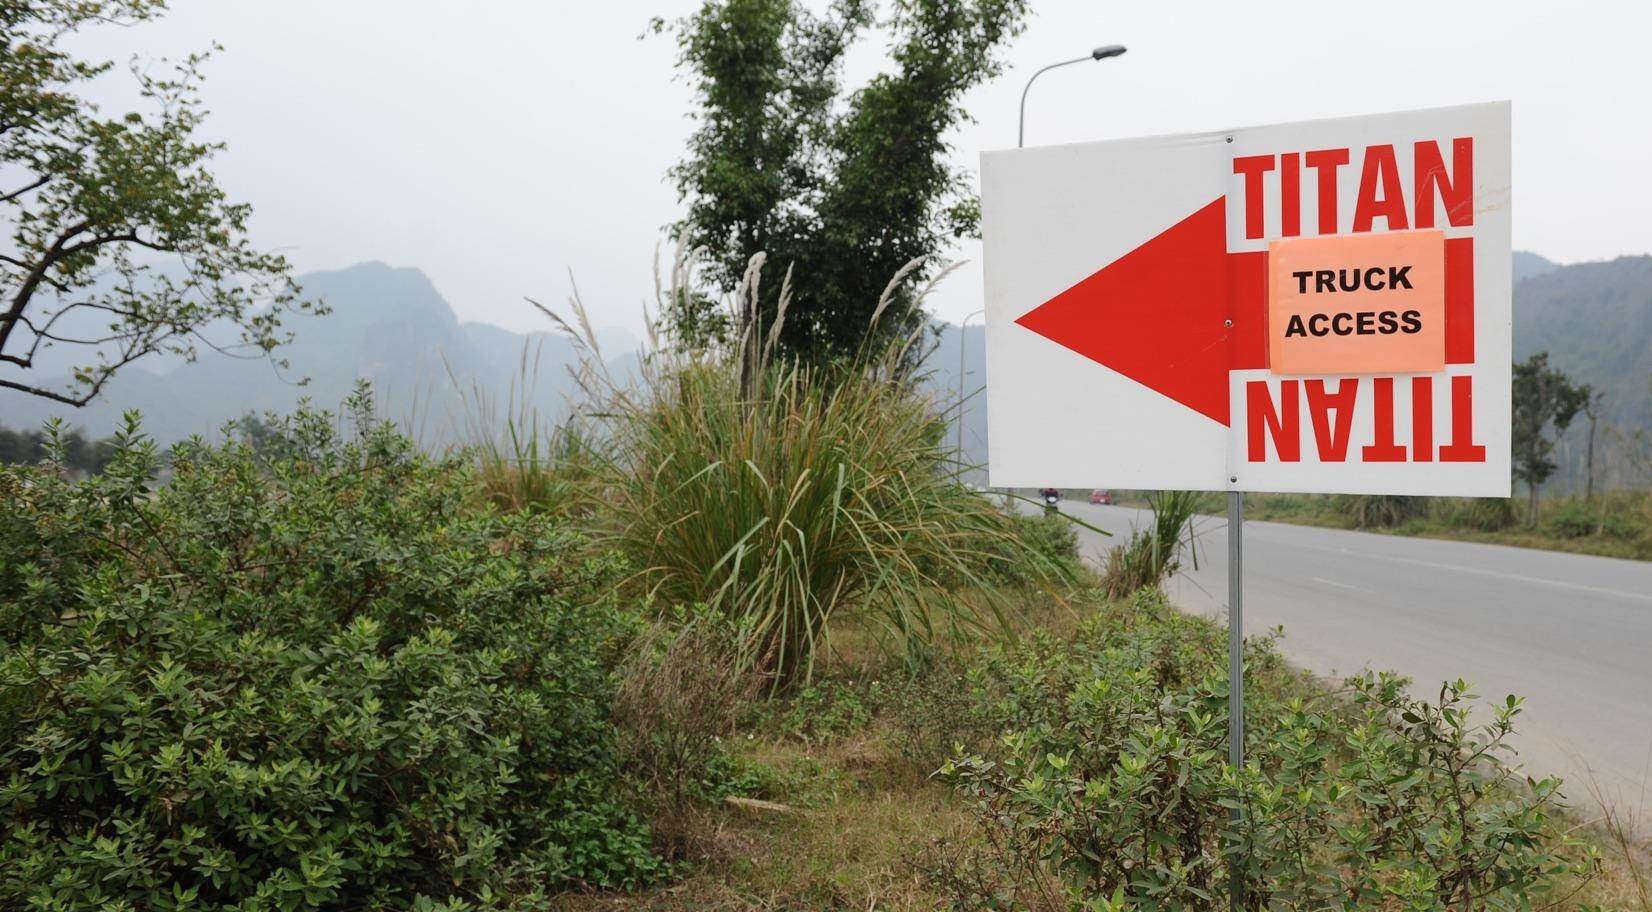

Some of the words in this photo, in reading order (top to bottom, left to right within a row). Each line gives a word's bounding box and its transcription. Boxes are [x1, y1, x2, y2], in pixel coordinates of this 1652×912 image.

[1233, 137, 1474, 240] TITAN
[1292, 266, 1413, 294] TRUCK
[1285, 310, 1422, 338] ACCESS
[1246, 375, 1486, 462] TITAN
